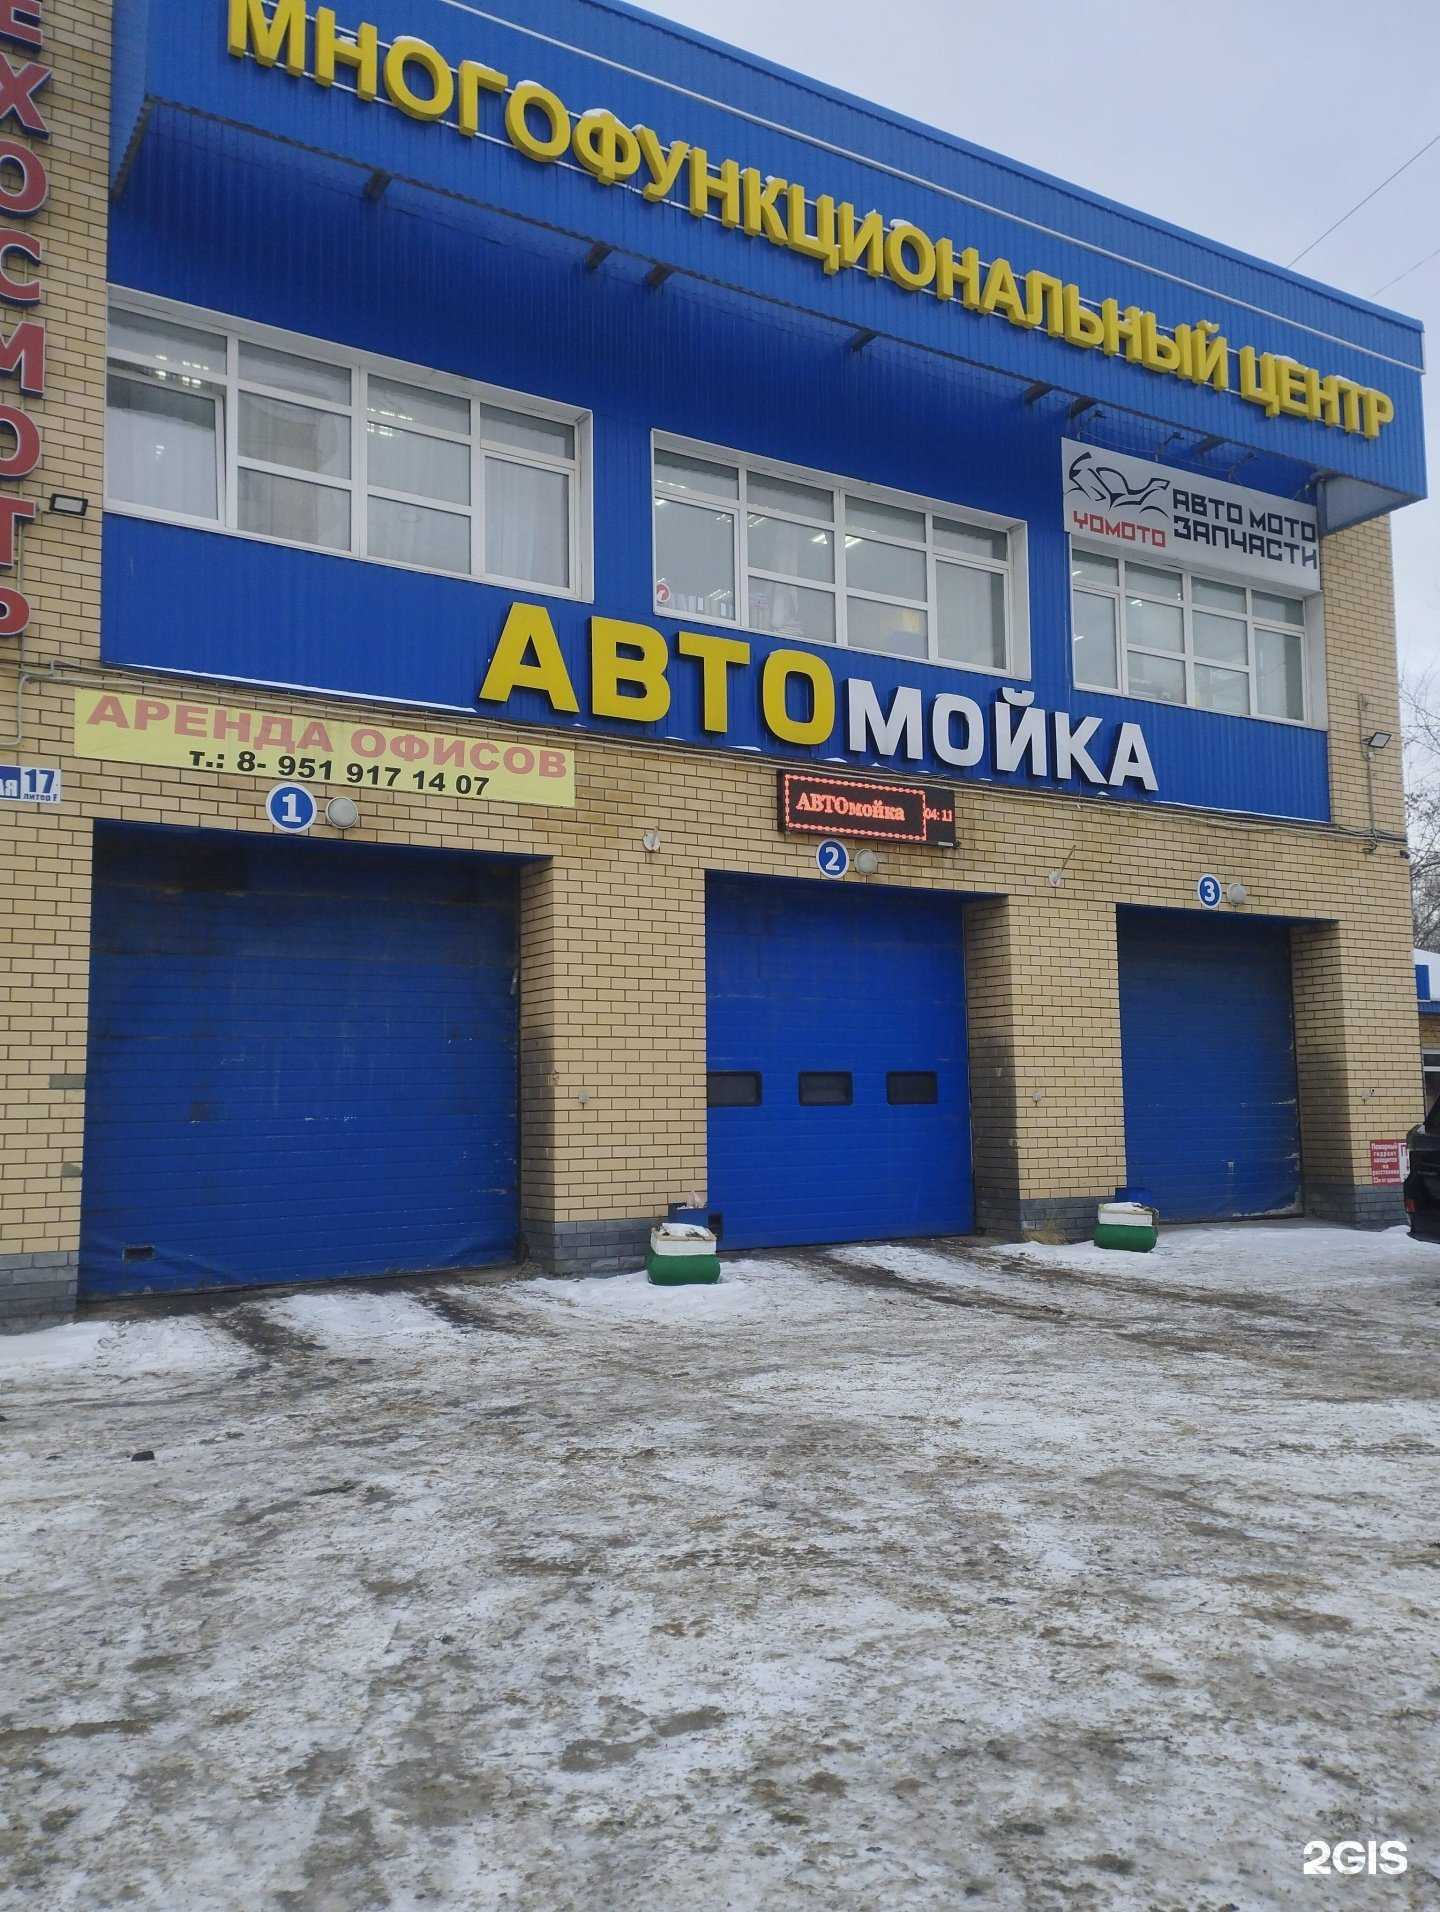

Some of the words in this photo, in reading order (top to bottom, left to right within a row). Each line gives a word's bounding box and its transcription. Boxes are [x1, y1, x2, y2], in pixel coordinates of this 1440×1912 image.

[228, 0, 1230, 391] МНОГОФУНКЦИОНАЛЬНЫЙ
[1238, 346, 1395, 438] ЦЕНТР
[1172, 488, 1243, 526] АВТО
[1249, 507, 1317, 544] МОТО
[1173, 515, 1318, 571] ЗАПЧАСТИ
[86, 694, 334, 754] АРЕНДА
[350, 727, 567, 779] ОФИСОВ
[24, 768, 55, 794] 17
[278, 755, 333, 781] 951
[346, 762, 402, 787] 917
[412, 770, 446, 792] 14
[455, 774, 490, 796] 07
[282, 793, 302, 823] 1
[796, 791, 905, 822] АВТОмойка
[825, 846, 840, 871] 2
[1204, 880, 1216, 902] 3
